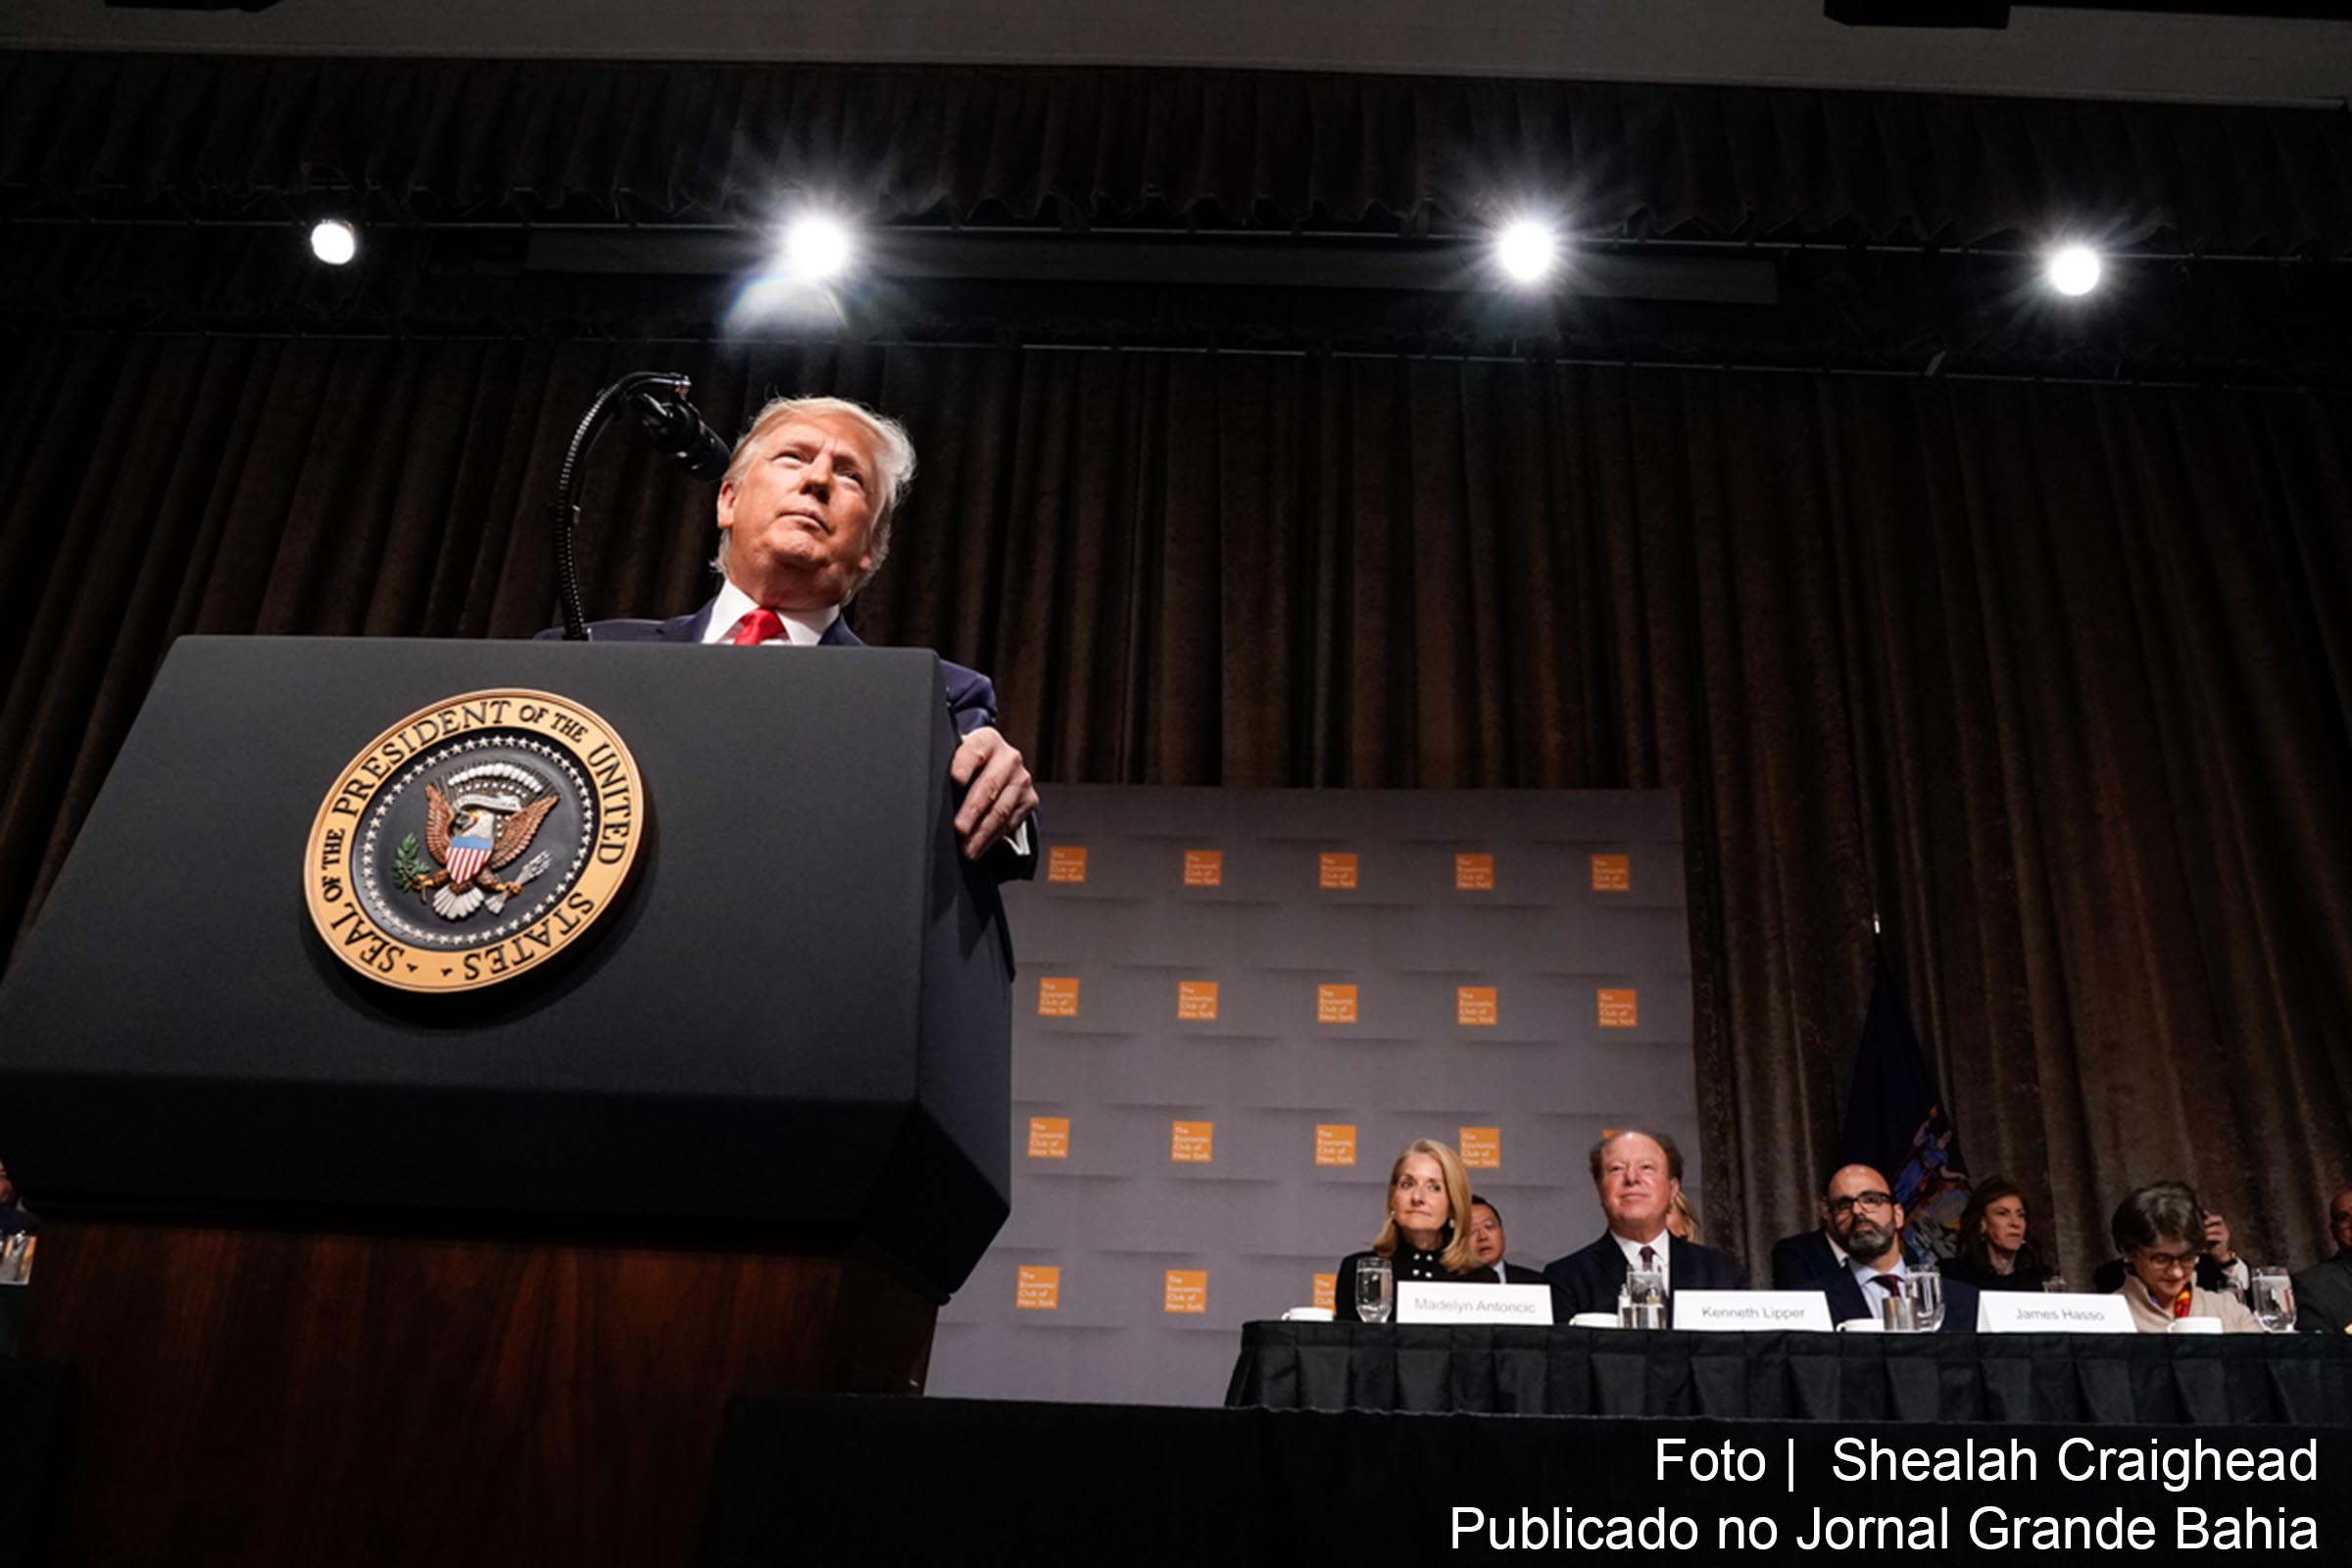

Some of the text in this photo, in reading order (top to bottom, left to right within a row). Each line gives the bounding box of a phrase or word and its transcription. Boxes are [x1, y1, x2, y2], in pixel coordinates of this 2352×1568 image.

[321, 700, 632, 981] SEAL OF THE PRESIDENT OF THE UNITED STATES
[1414, 1297, 1536, 1314] Madelyn Antoncic
[1701, 1305, 1805, 1323] Kenneth Lipper
[2016, 1307, 2105, 1321] James Hasso
